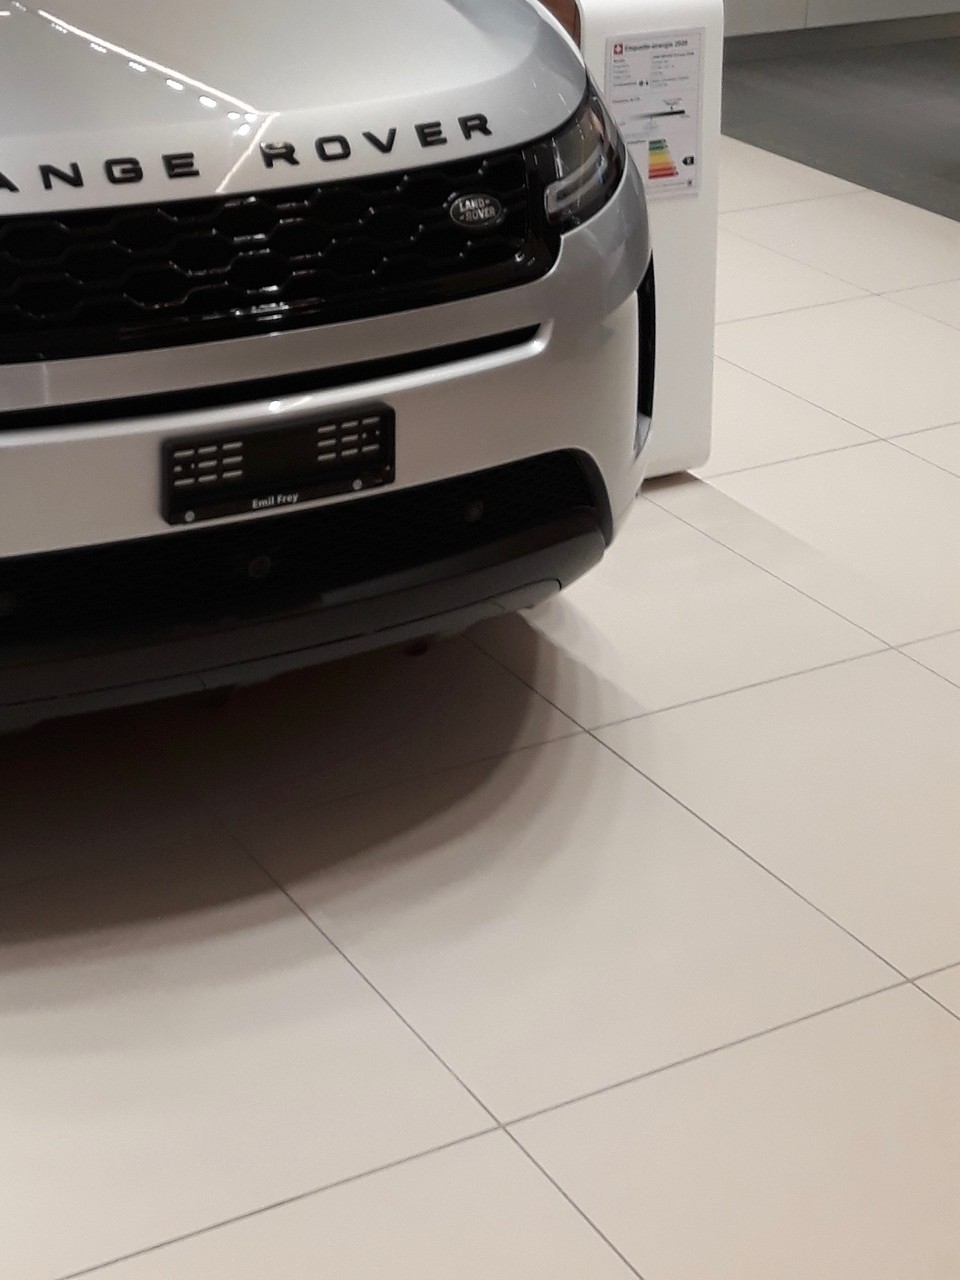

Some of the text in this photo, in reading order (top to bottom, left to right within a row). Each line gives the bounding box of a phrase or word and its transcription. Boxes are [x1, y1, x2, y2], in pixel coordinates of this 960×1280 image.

[259, 113, 493, 169] ROVER
[458, 198, 485, 213] LAND
[465, 206, 496, 222] ROVER
[252, 493, 299, 509] Emil Frey
